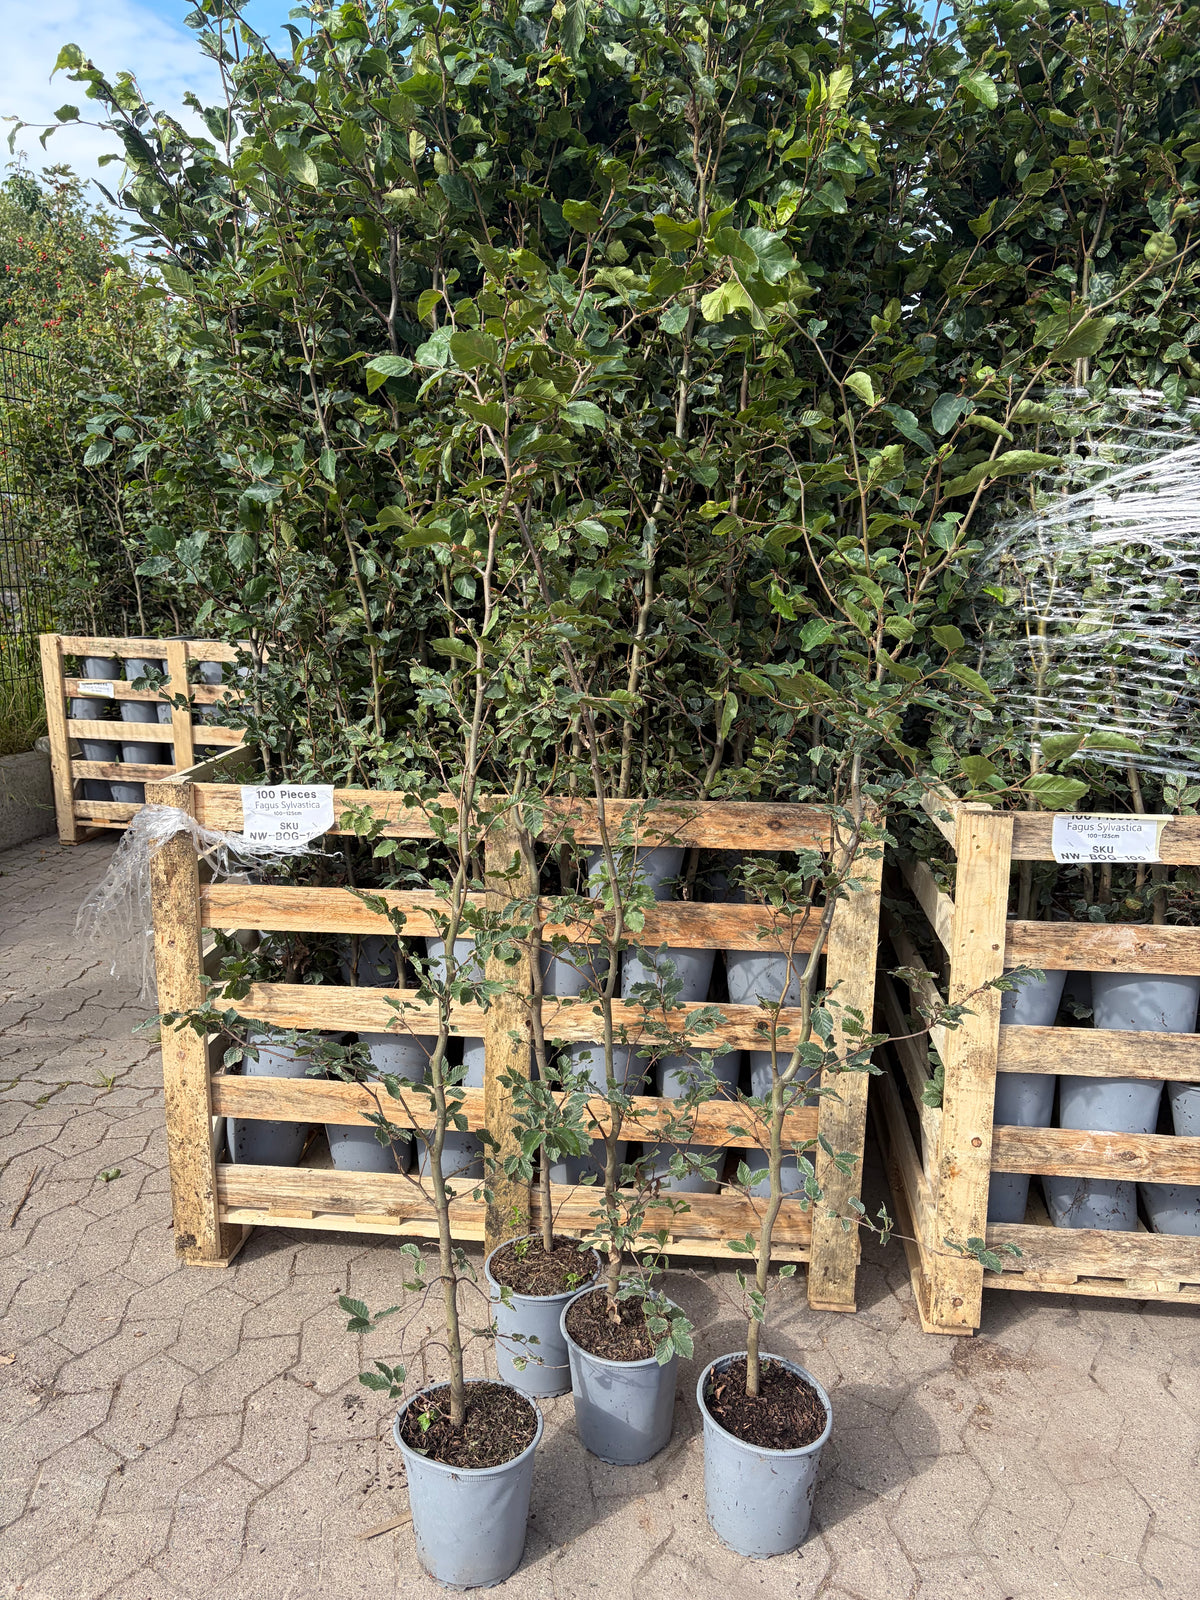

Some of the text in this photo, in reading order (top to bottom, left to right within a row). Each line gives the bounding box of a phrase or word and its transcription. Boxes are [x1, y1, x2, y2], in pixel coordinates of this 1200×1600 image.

[256, 790, 317, 799] 100 Pieces
[255, 801, 320, 811] Fagus Sylvastica
[280, 822, 299, 830] SKU
[1067, 822, 1142, 833] Fagus Sylvastica
[250, 831, 320, 841] NW-BOG-1
[1092, 846, 1114, 854] SKU
[1061, 853, 1146, 861] NW-BOG-100
